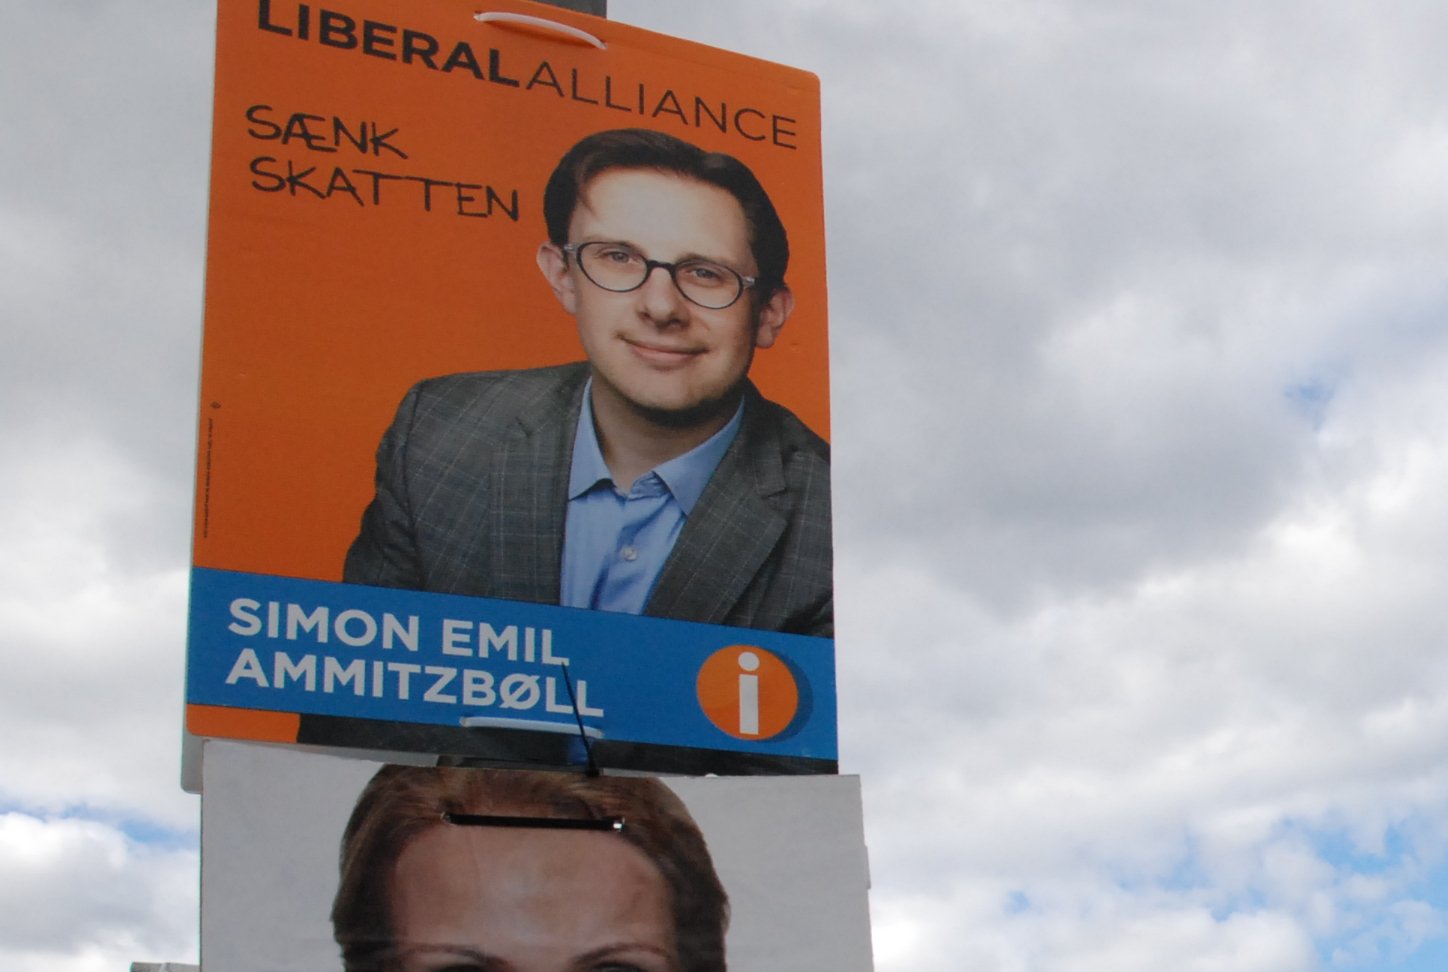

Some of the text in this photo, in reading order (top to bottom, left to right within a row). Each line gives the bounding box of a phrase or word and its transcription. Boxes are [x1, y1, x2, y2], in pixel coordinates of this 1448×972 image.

[245, 104, 409, 160] SÆNK
[250, 155, 519, 221] SKATTEN
[227, 597, 570, 667] SIMON EMIL
[225, 648, 605, 718] AMMITZBØLL
